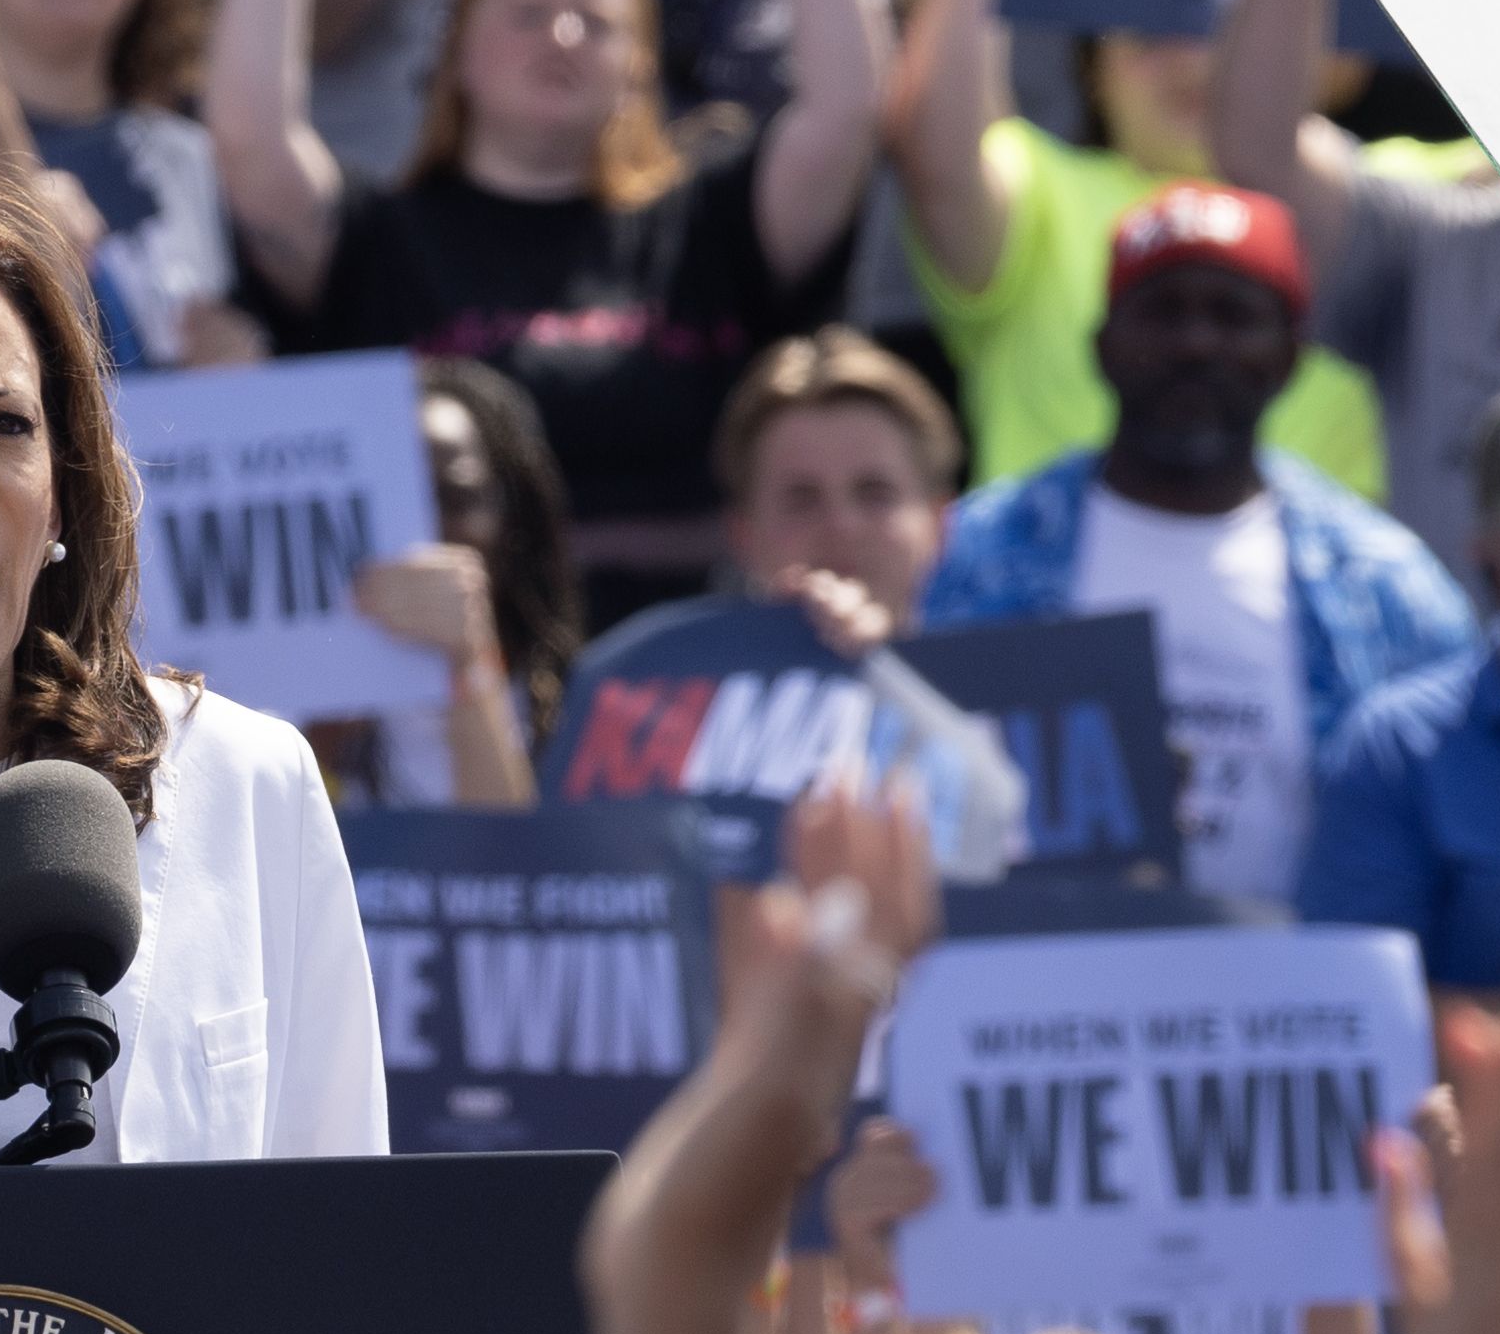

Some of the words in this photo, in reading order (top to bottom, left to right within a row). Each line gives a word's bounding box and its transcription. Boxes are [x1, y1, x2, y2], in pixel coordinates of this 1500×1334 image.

[160, 487, 377, 629] WIN
[366, 929, 442, 1069] E
[454, 927, 690, 1079] WIN
[966, 1015, 1124, 1061] WHEN
[1144, 1011, 1220, 1049] WE
[1244, 1003, 1370, 1047] VOTE
[962, 1079, 1132, 1211] WE
[1158, 1071, 1380, 1203] WIN
